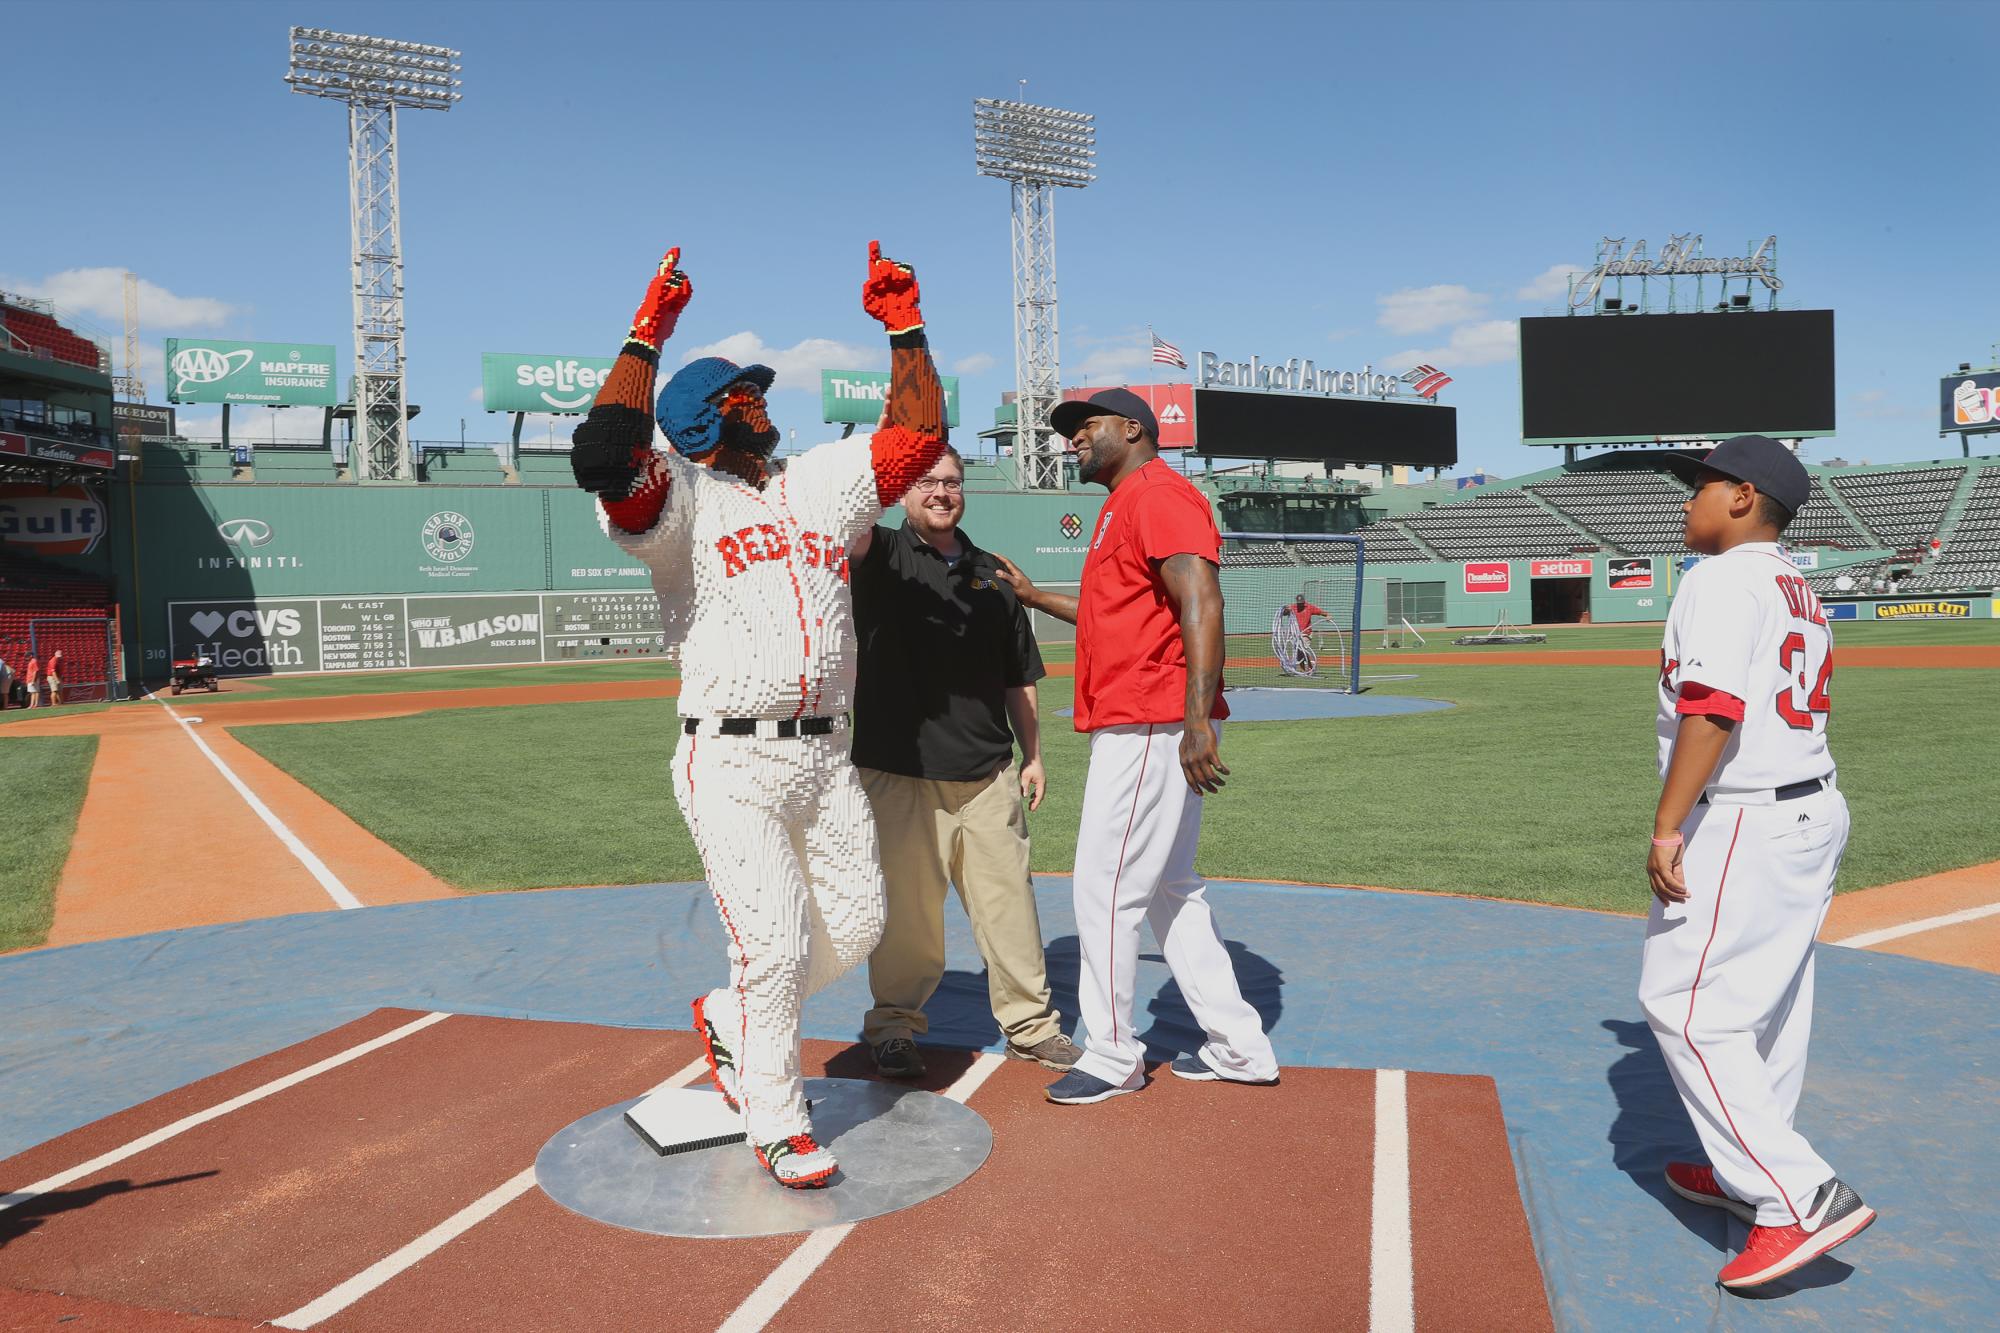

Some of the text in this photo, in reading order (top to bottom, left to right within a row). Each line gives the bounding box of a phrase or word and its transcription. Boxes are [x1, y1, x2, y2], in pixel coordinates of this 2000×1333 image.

[180, 351, 223, 380] AAA
[260, 362, 330, 375] MAPFRE
[1198, 351, 1400, 398] Bank of America
[265, 377, 327, 388] INSURANCE
[225, 392, 281, 401] Auto Insurance
[37, 446, 76, 461] Safelite
[0, 505, 96, 534] Gulf
[424, 513, 464, 535] RED SOX
[426, 532, 472, 560] SCHOLARS
[715, 524, 791, 578] RED
[571, 569, 586, 577] RED
[587, 568, 602, 576] SOX
[618, 567, 647, 576] ANNUAL
[1539, 562, 1582, 575] aetna
[1609, 567, 1651, 577] Safelite
[1637, 599, 1653, 607] 420
[1878, 603, 1935, 617] GRANITE
[1938, 602, 1969, 616] CITY
[227, 608, 301, 638] CVS
[411, 618, 450, 629] WHO BUT
[323, 643, 360, 651] BALTIMORE
[609, 638, 632, 646] STRIKE
[146, 650, 166, 659] 310
[195, 640, 304, 668] Health
